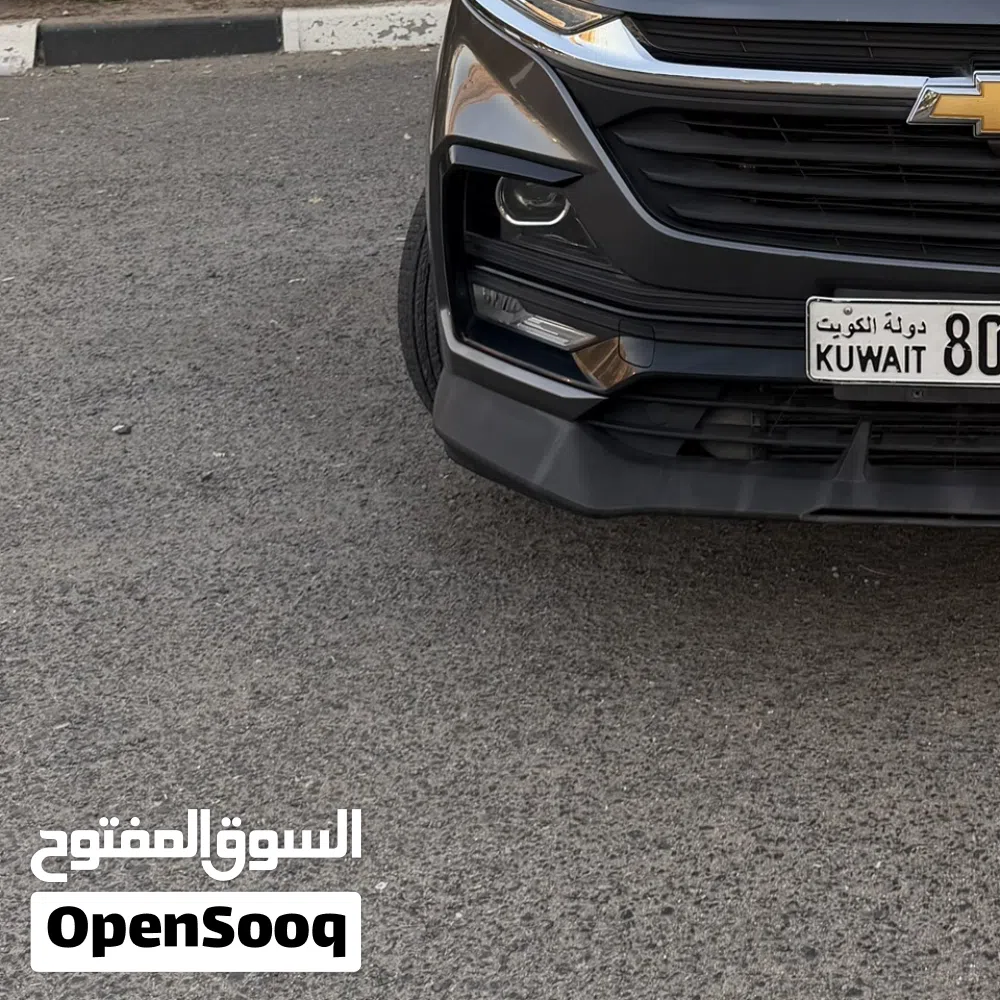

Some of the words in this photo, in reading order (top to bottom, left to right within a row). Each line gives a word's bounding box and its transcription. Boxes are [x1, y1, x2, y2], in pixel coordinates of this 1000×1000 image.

[816, 315, 877, 339] الكويت
[883, 311, 927, 339] دولة
[816, 343, 927, 373] KUWAIT
